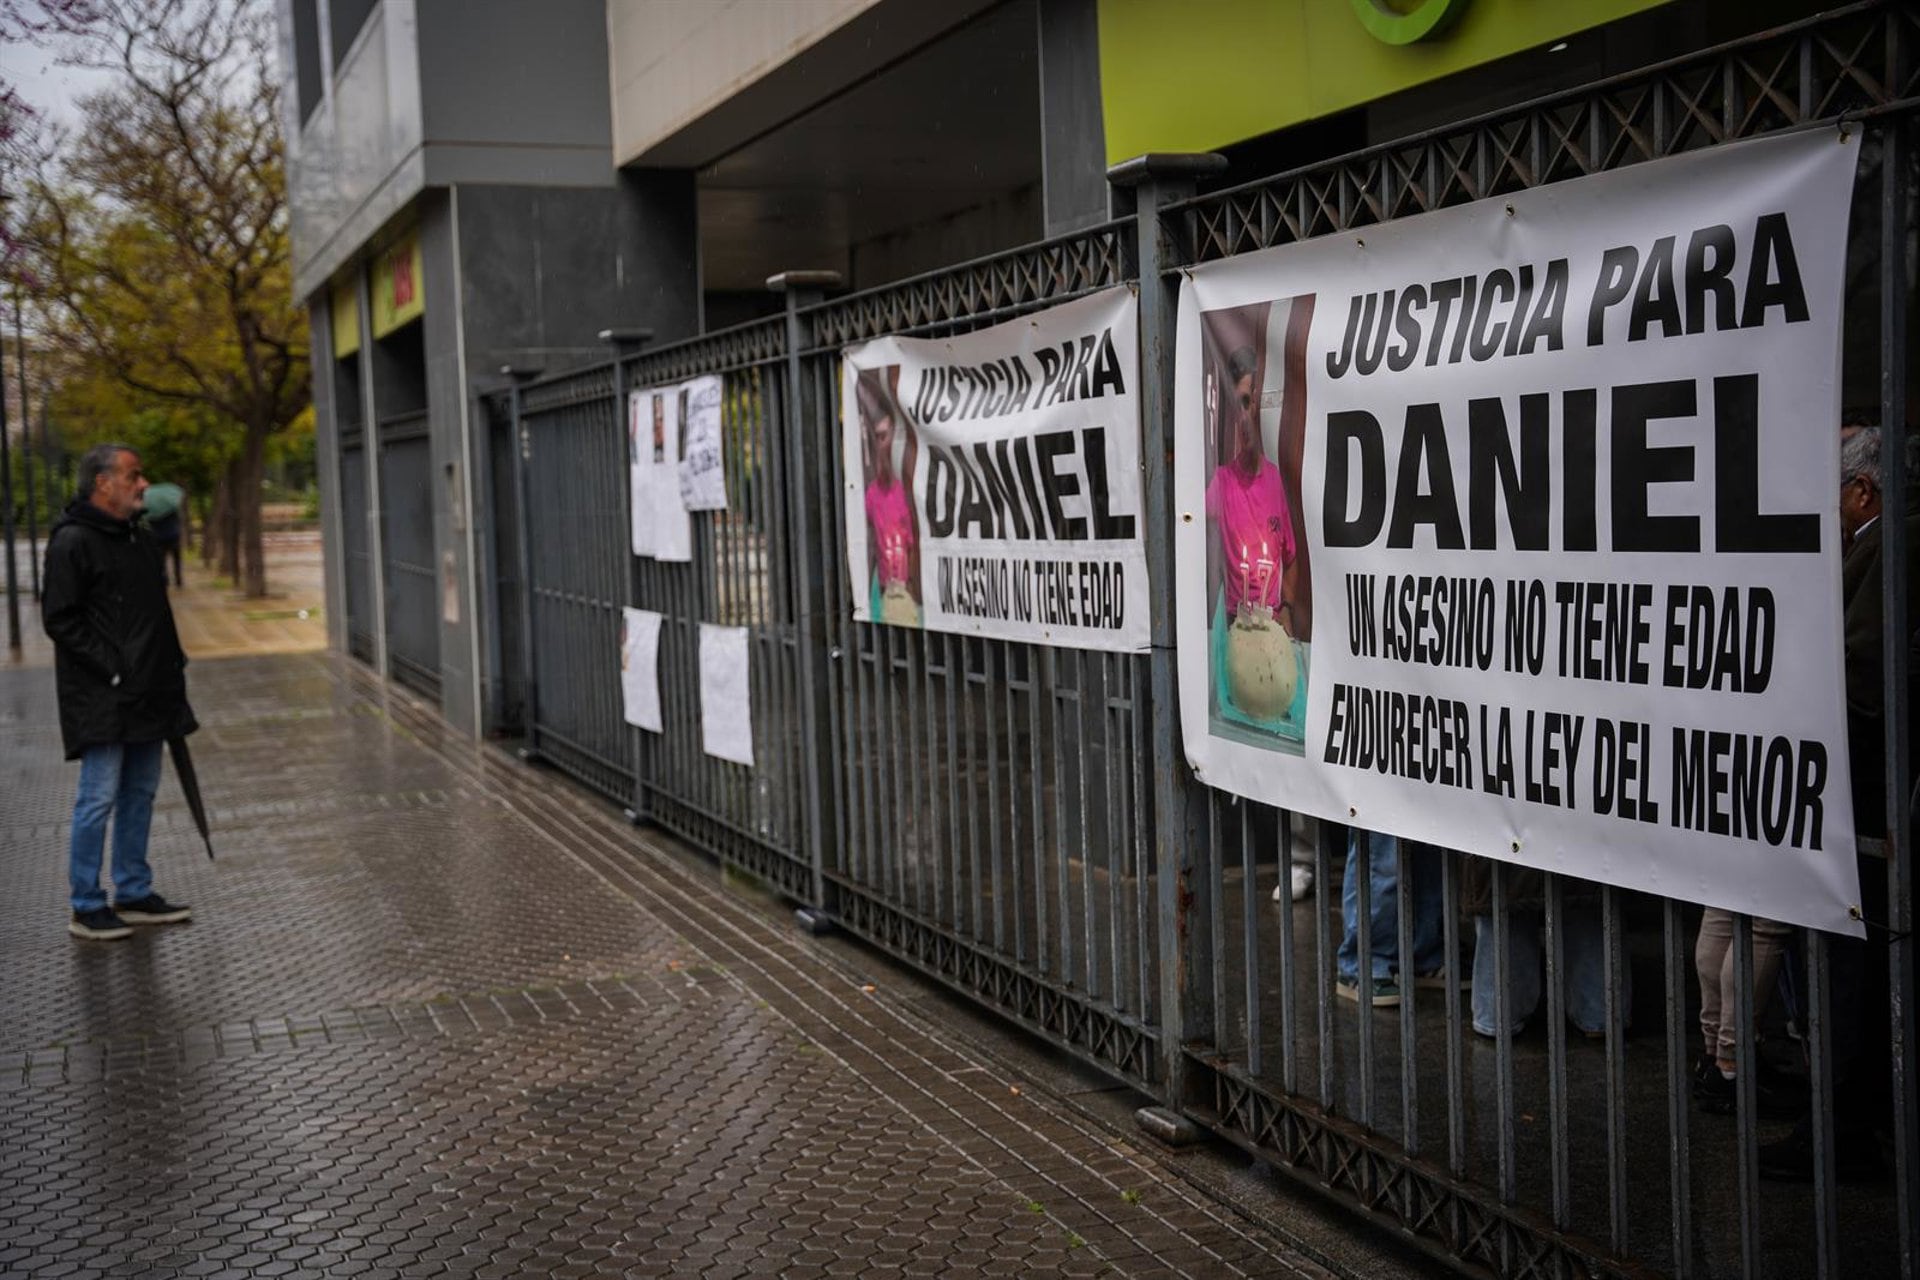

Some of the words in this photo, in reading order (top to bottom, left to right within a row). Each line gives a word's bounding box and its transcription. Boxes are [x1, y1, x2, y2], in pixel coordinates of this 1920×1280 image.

[1326, 258, 1568, 379] JUSTICIA
[1587, 212, 1810, 347] PARA
[907, 356, 1032, 425] JUSTICIA
[1032, 327, 1125, 410] PARA
[925, 427, 1136, 540] DANIEL
[1323, 373, 1821, 553] DANIEL
[957, 557, 1008, 620] ASESINO
[1013, 559, 1032, 623] NO
[1035, 560, 1078, 626] TIENE
[1079, 562, 1124, 629] EDAD
[1346, 574, 1376, 657] UN
[1383, 575, 1495, 671] ASESINO
[1504, 579, 1546, 676] NO
[1555, 581, 1653, 684] TIENE
[1663, 585, 1776, 694] EDAD
[1323, 683, 1473, 790] ENDURECER
[1480, 704, 1515, 799] LA
[1525, 710, 1584, 809] LEY
[1593, 717, 1659, 824] DEL
[1672, 727, 1828, 851] MENOR
